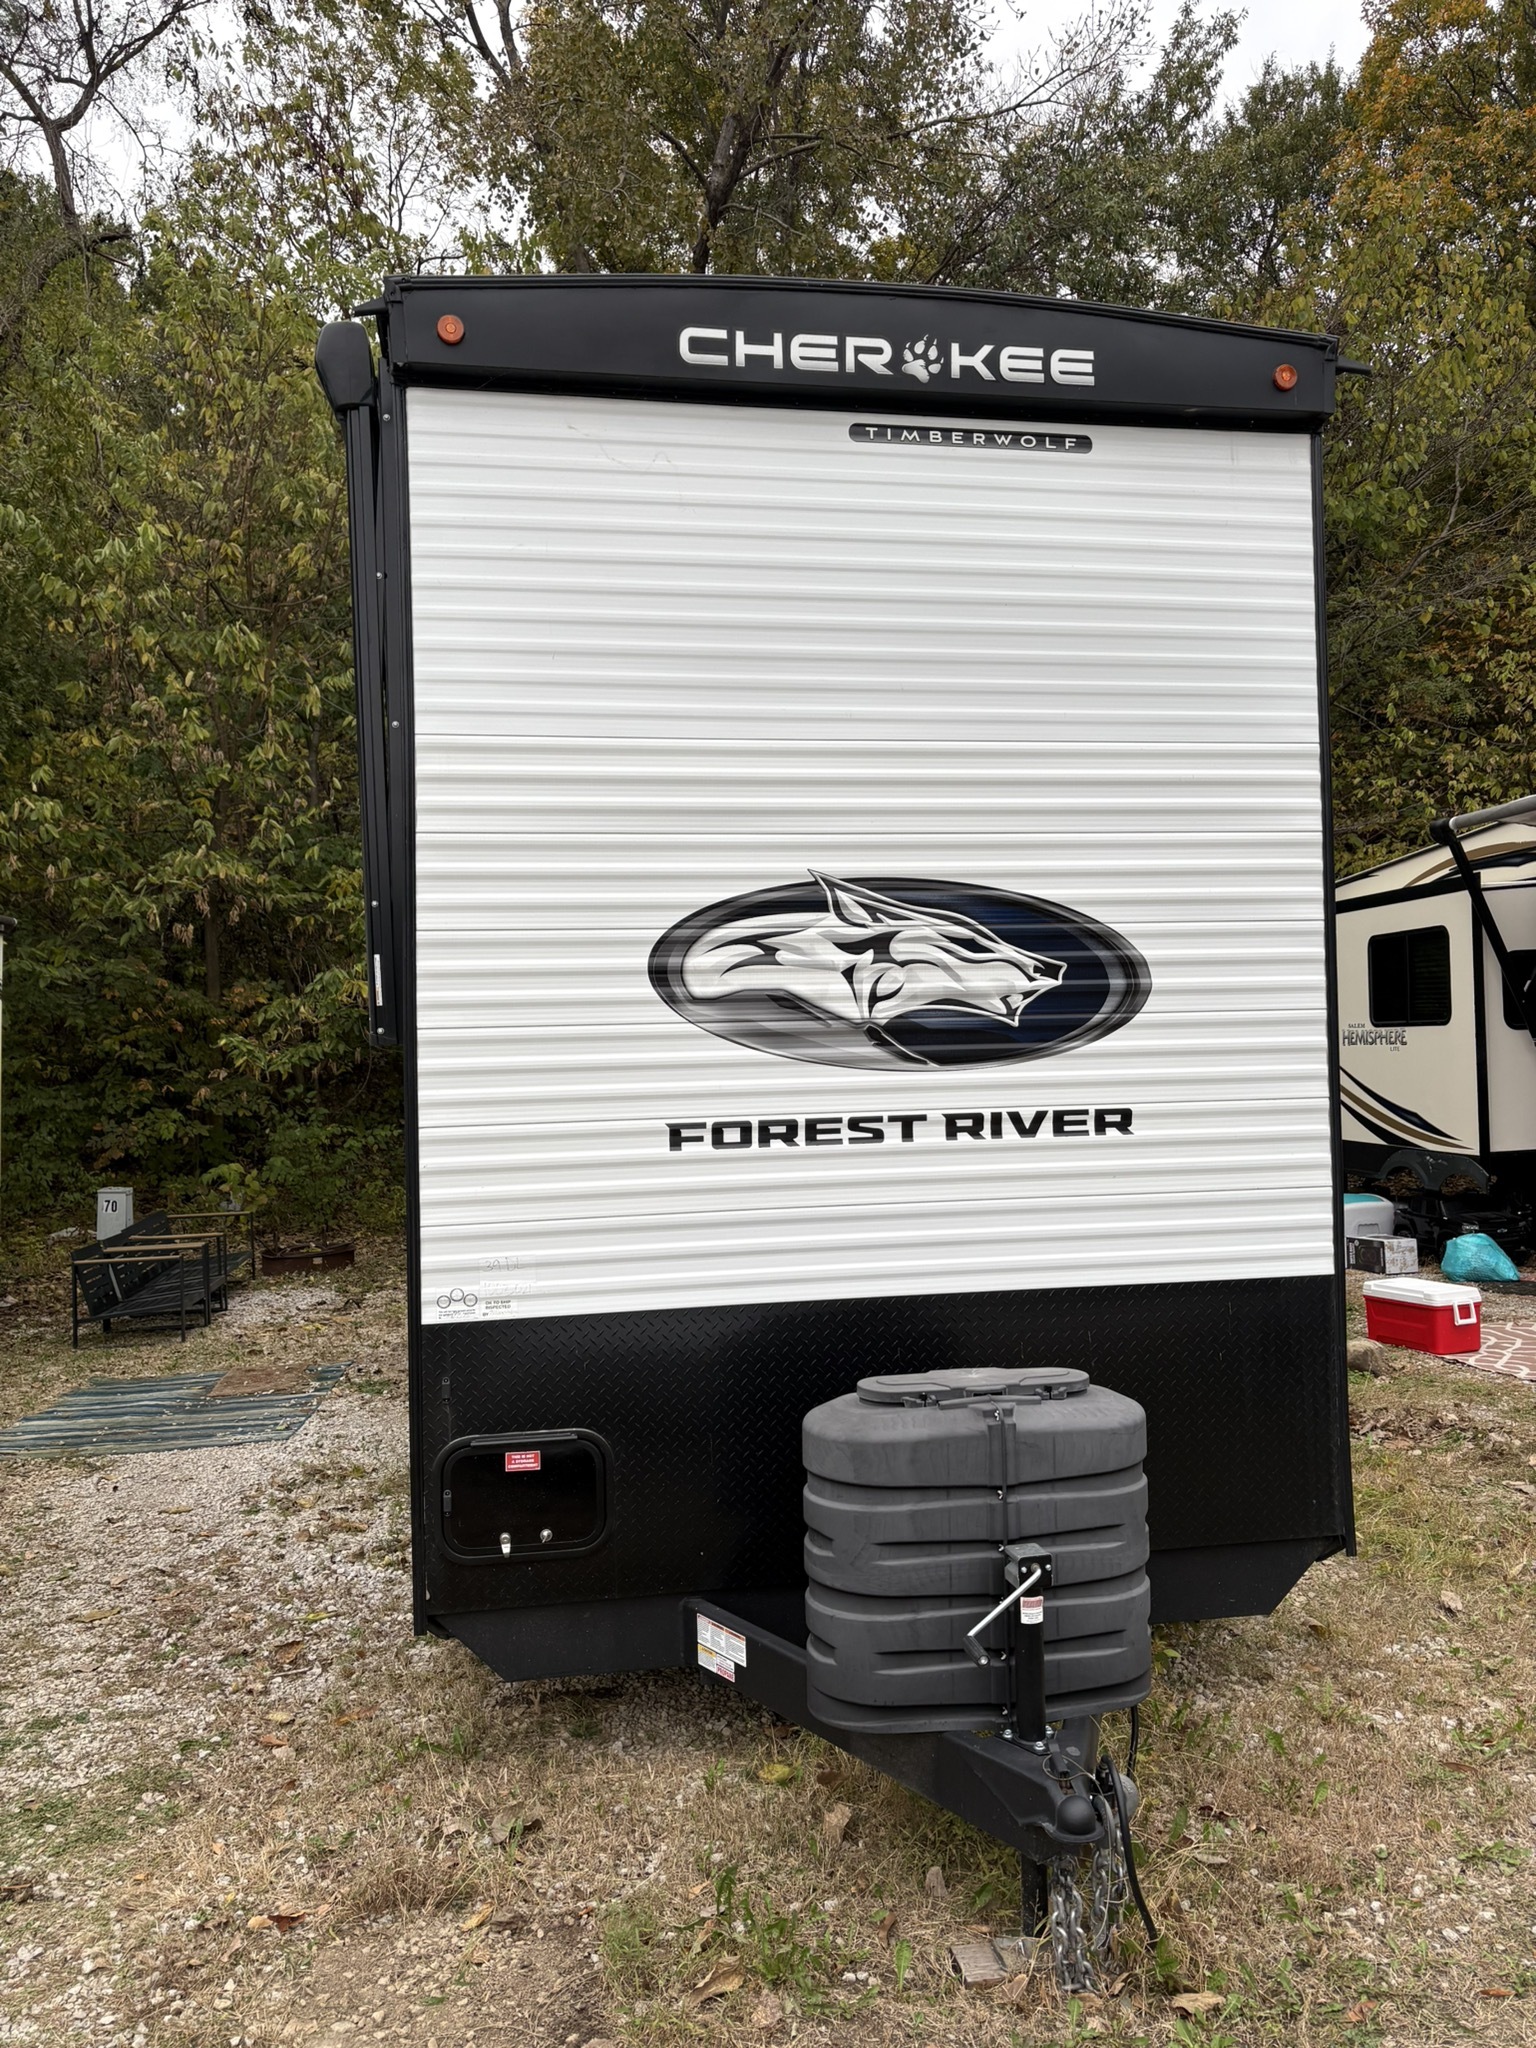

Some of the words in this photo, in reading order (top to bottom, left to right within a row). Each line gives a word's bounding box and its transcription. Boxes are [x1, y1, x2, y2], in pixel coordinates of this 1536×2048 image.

[864, 426, 1077, 450] TIMBERWOLF
[1342, 1028, 1408, 1046] HEMISPHERE
[664, 1114, 928, 1152] FOREST
[941, 1107, 1135, 1141] RIVER
[104, 1200, 117, 1212] 70
